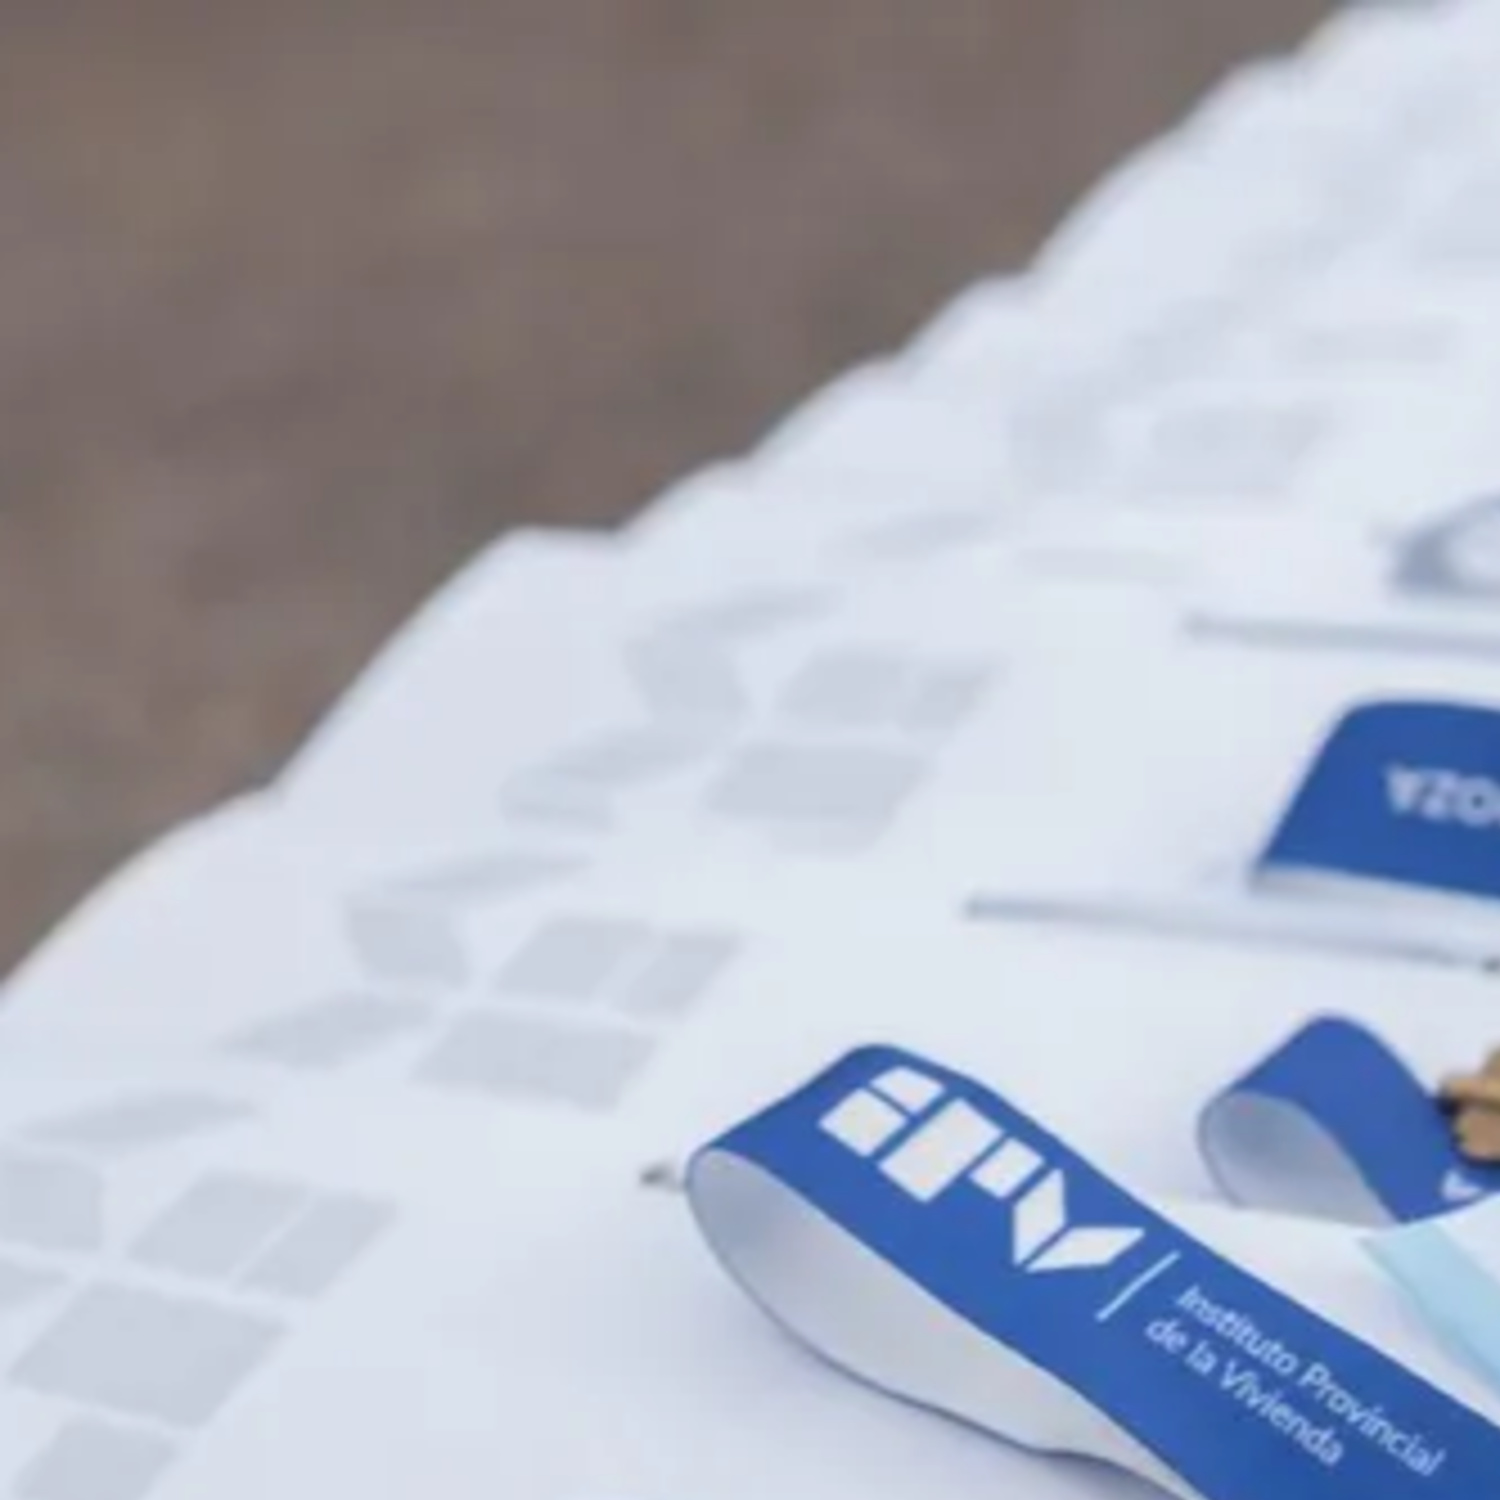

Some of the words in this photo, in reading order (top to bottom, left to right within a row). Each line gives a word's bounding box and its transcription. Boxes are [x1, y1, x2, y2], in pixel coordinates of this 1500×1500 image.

[1145, 1319, 1187, 1352] de
[1184, 1340, 1218, 1376] la
[1220, 1358, 1344, 1466] Vivienda
[1176, 1284, 1299, 1376] Instituto
[1298, 1362, 1447, 1476] Provincial
